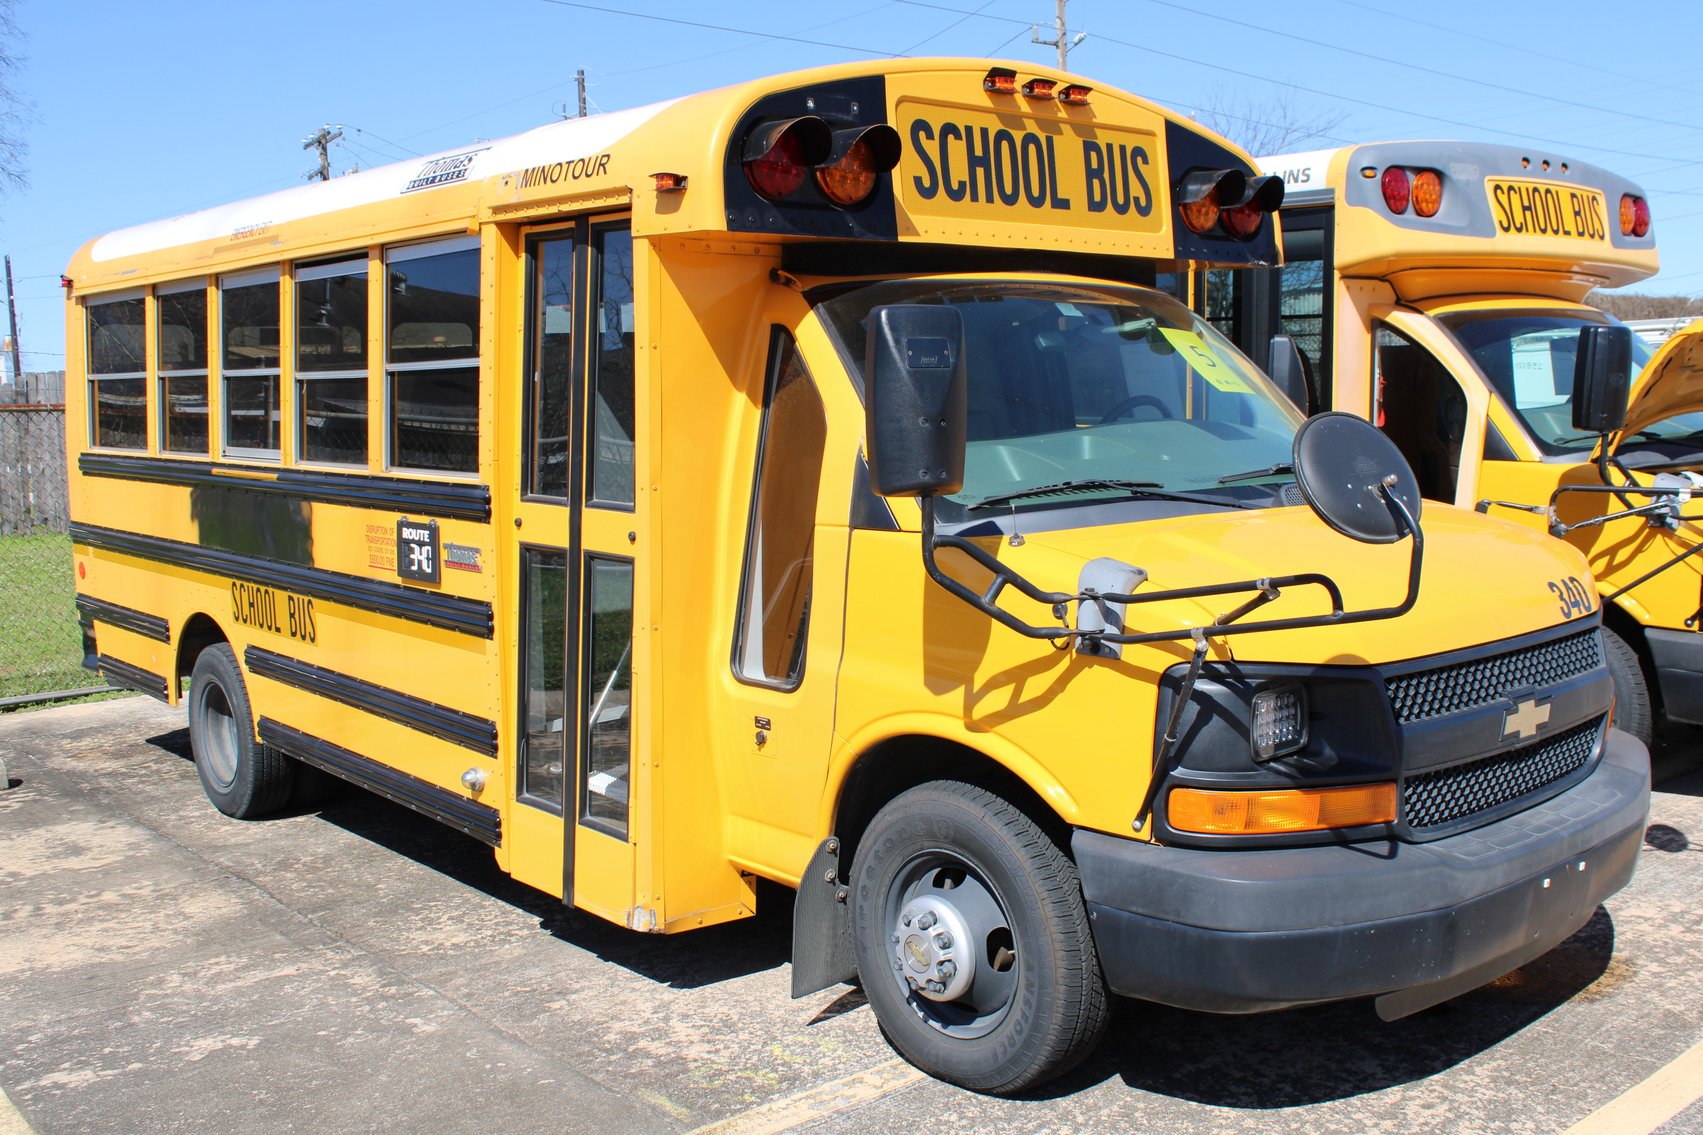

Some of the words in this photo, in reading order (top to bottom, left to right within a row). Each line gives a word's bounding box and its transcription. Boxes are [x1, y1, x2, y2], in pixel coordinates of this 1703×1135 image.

[406, 177, 433, 190] BUILT
[435, 168, 468, 184] BUSES
[520, 153, 611, 189] MINOTOUR
[910, 118, 1071, 210] SCHOOL
[1082, 139, 1153, 217] BUS
[1493, 183, 1571, 236] SCHOOL
[1570, 192, 1605, 240] BUS
[1189, 345, 1216, 367] 5
[402, 527, 430, 542] ROUTE
[409, 543, 432, 574] 340
[231, 581, 281, 633] SCHOOL
[288, 594, 315, 643] BUS
[1548, 576, 1592, 619] 340
